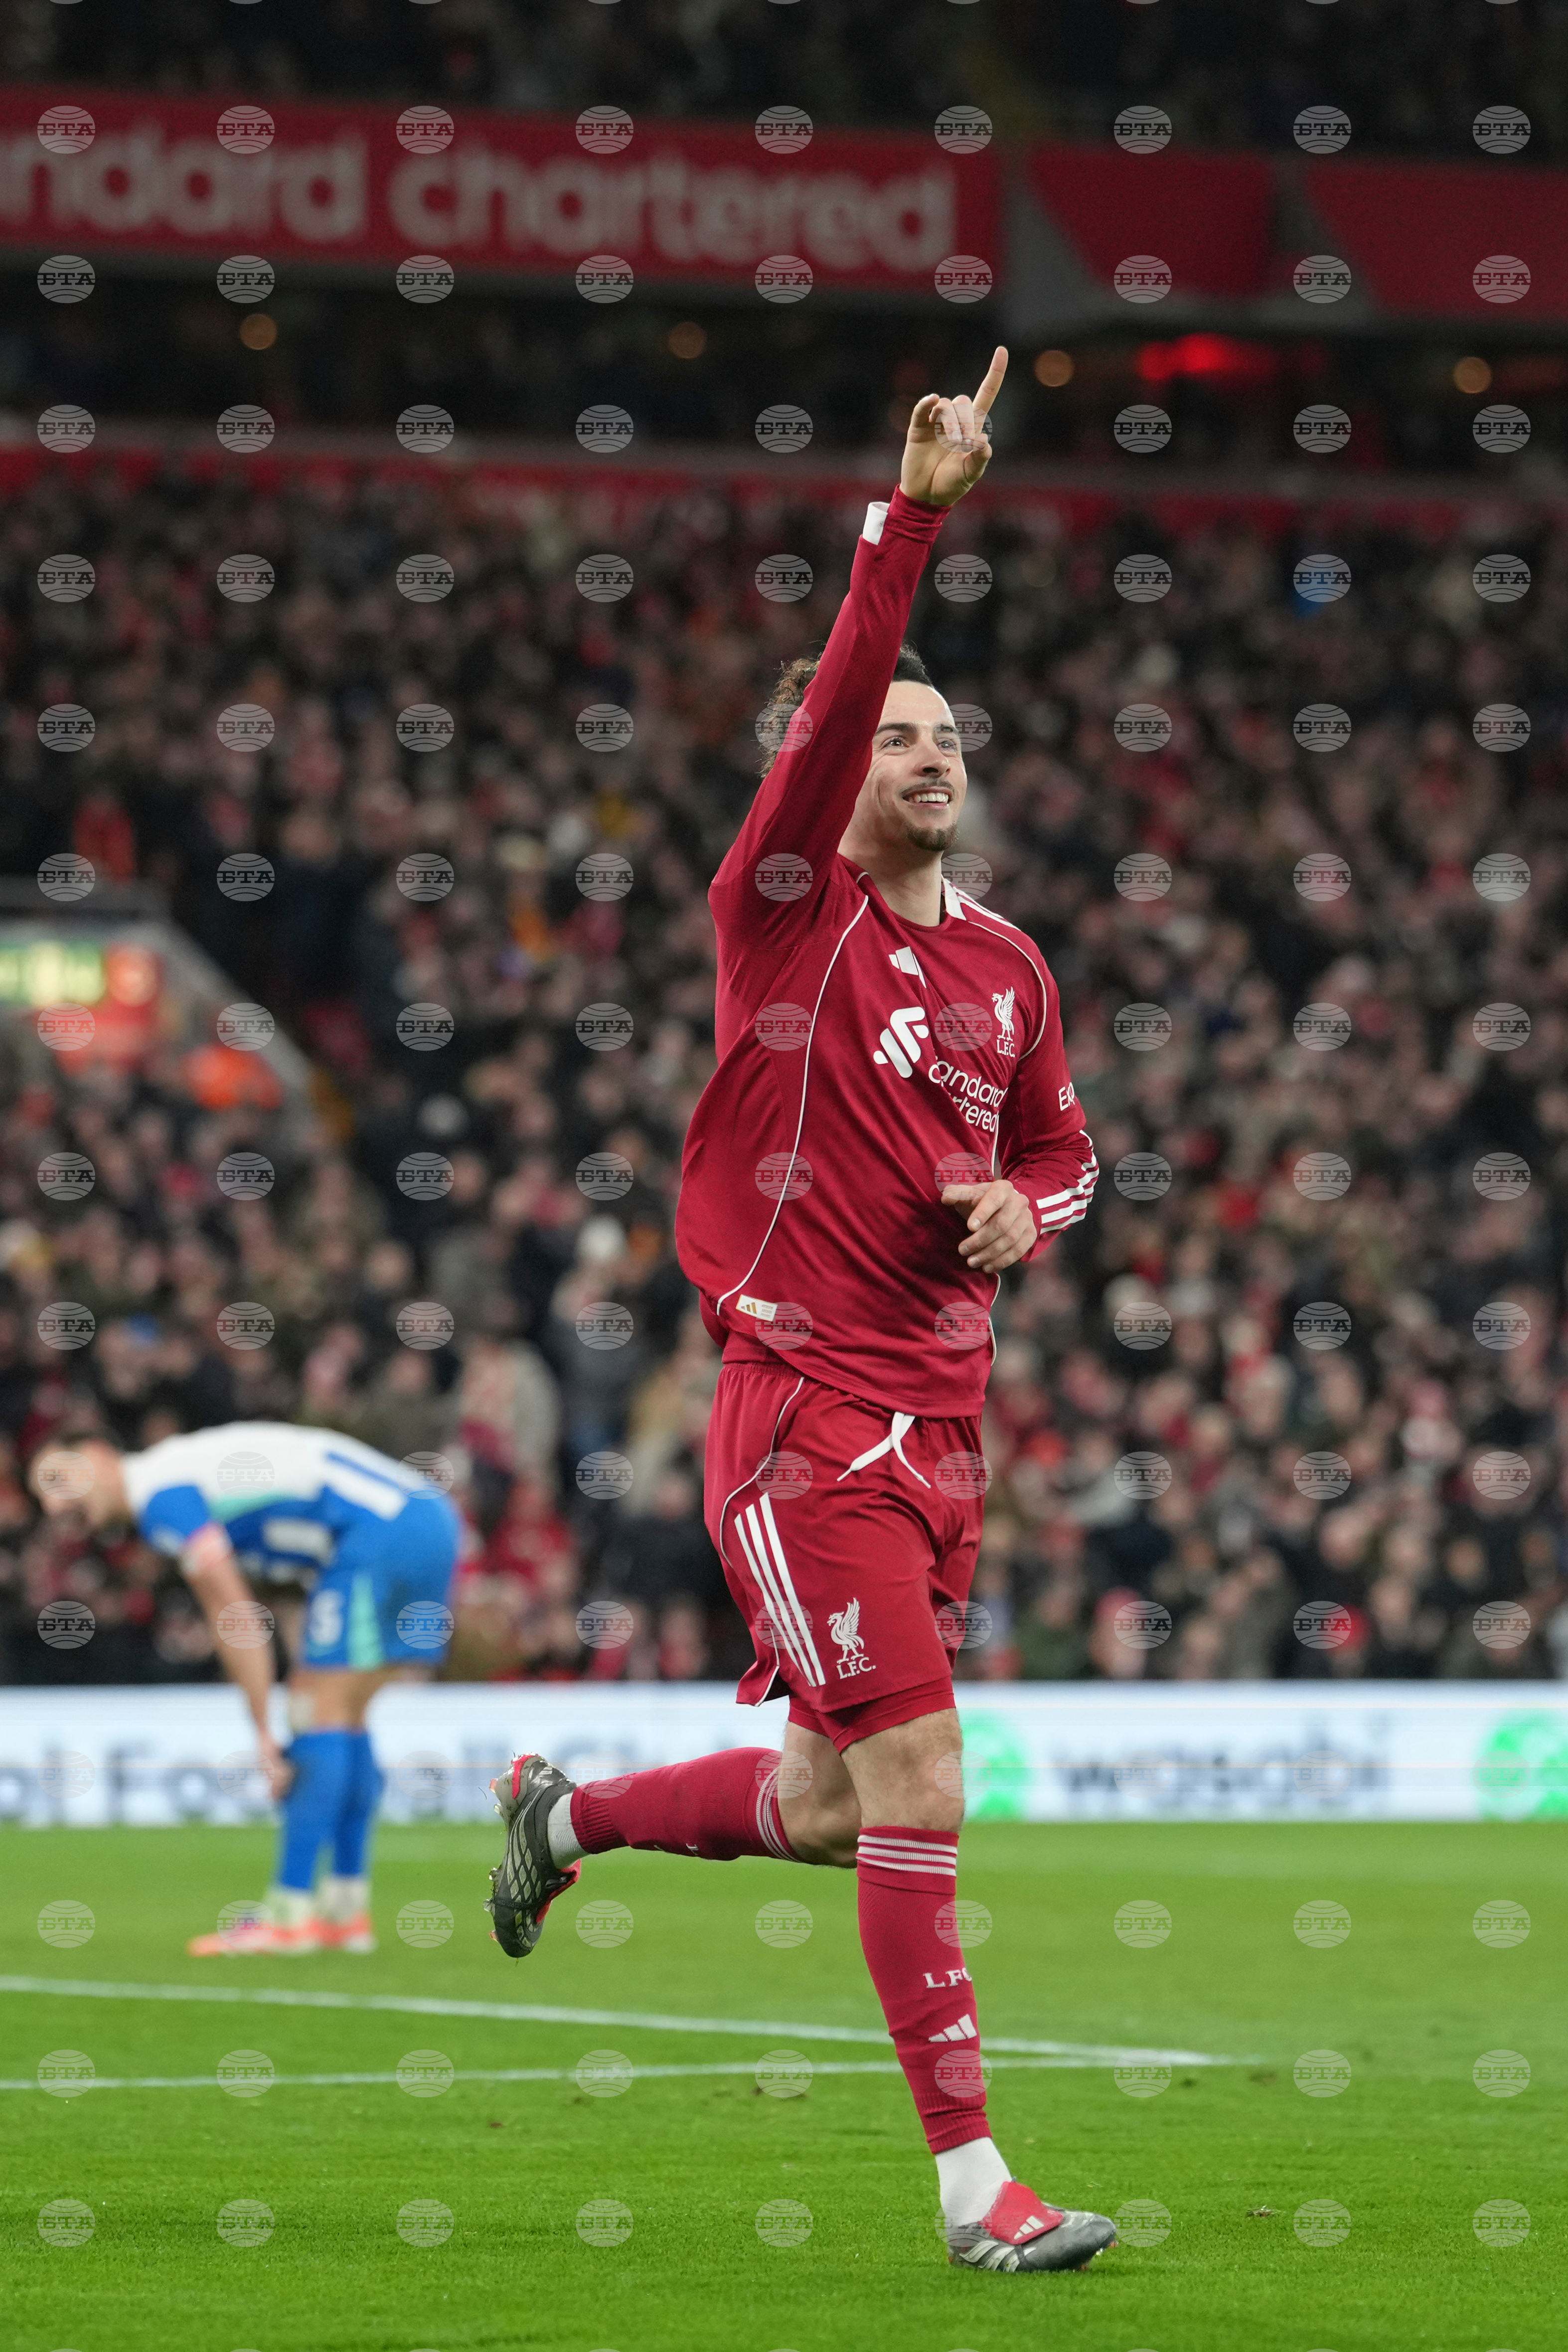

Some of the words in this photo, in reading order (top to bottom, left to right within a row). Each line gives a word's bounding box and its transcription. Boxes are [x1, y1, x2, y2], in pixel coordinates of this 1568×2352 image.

[390, 137, 954, 270] chartered
[997, 1039, 1015, 1058] L.F.C.
[836, 1657, 876, 1680] L.F.C.
